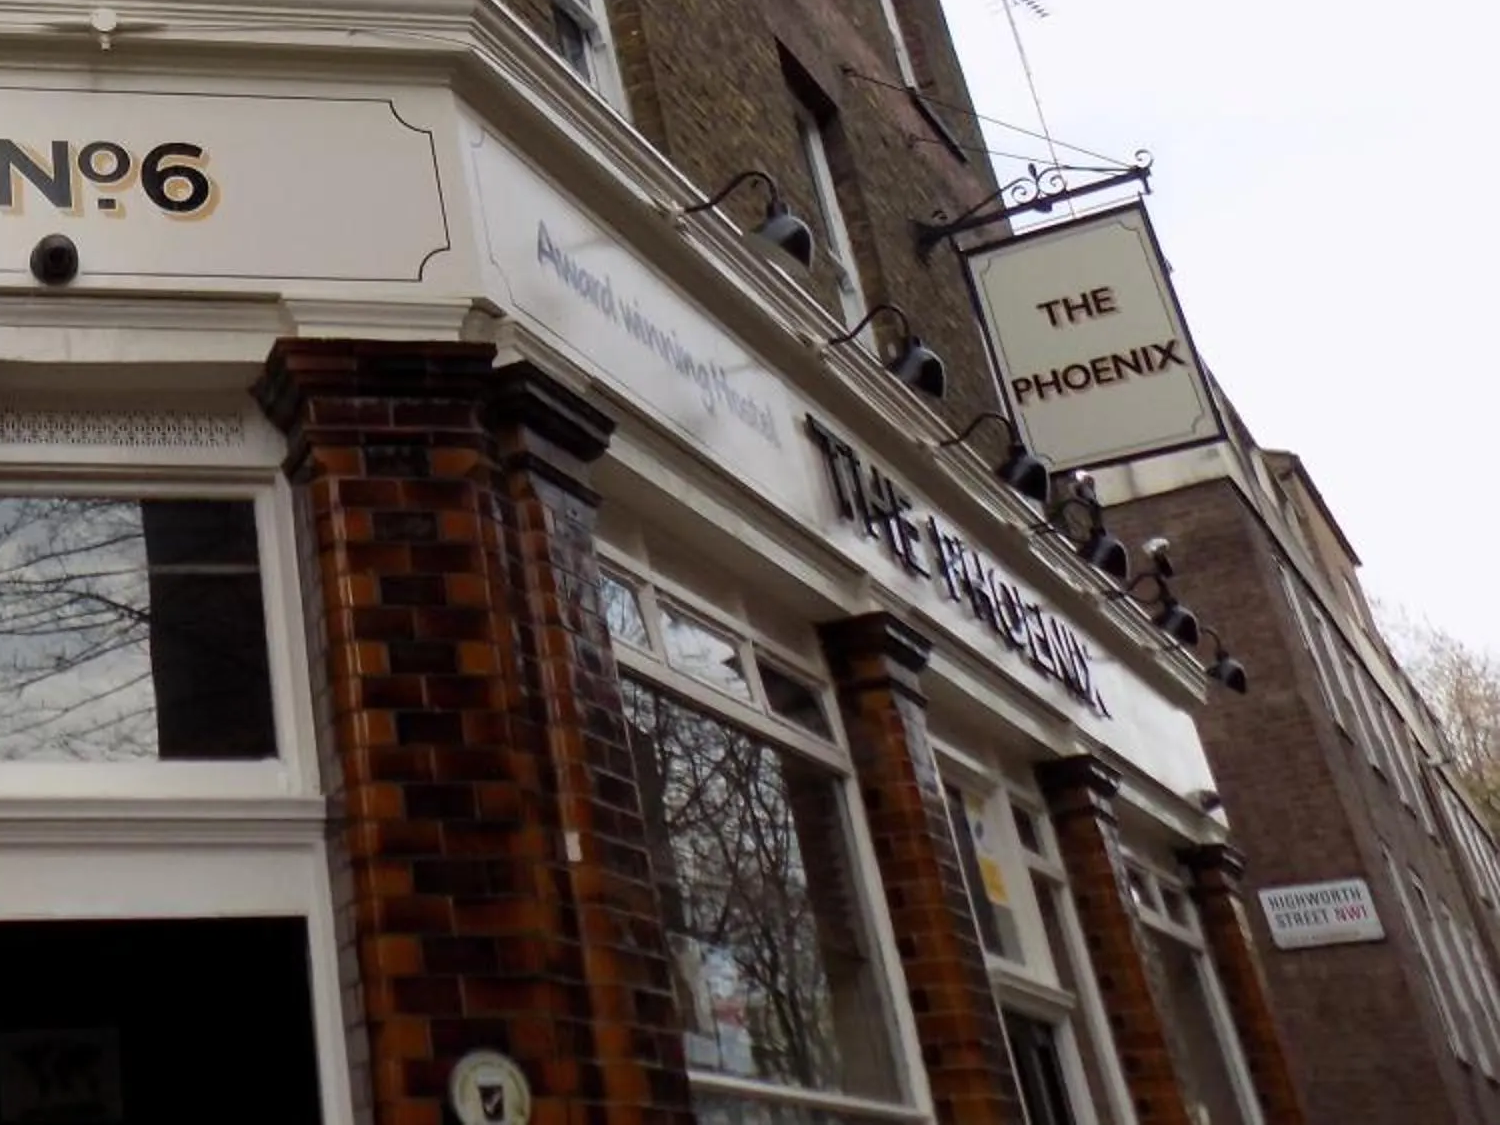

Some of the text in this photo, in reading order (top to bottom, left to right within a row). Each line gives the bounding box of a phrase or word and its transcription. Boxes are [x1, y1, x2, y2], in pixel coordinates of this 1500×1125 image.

[538, 219, 617, 324] Award
[1036, 286, 1118, 327] THE
[1011, 339, 1186, 405] PHOENIX
[1275, 908, 1329, 929] STREET
